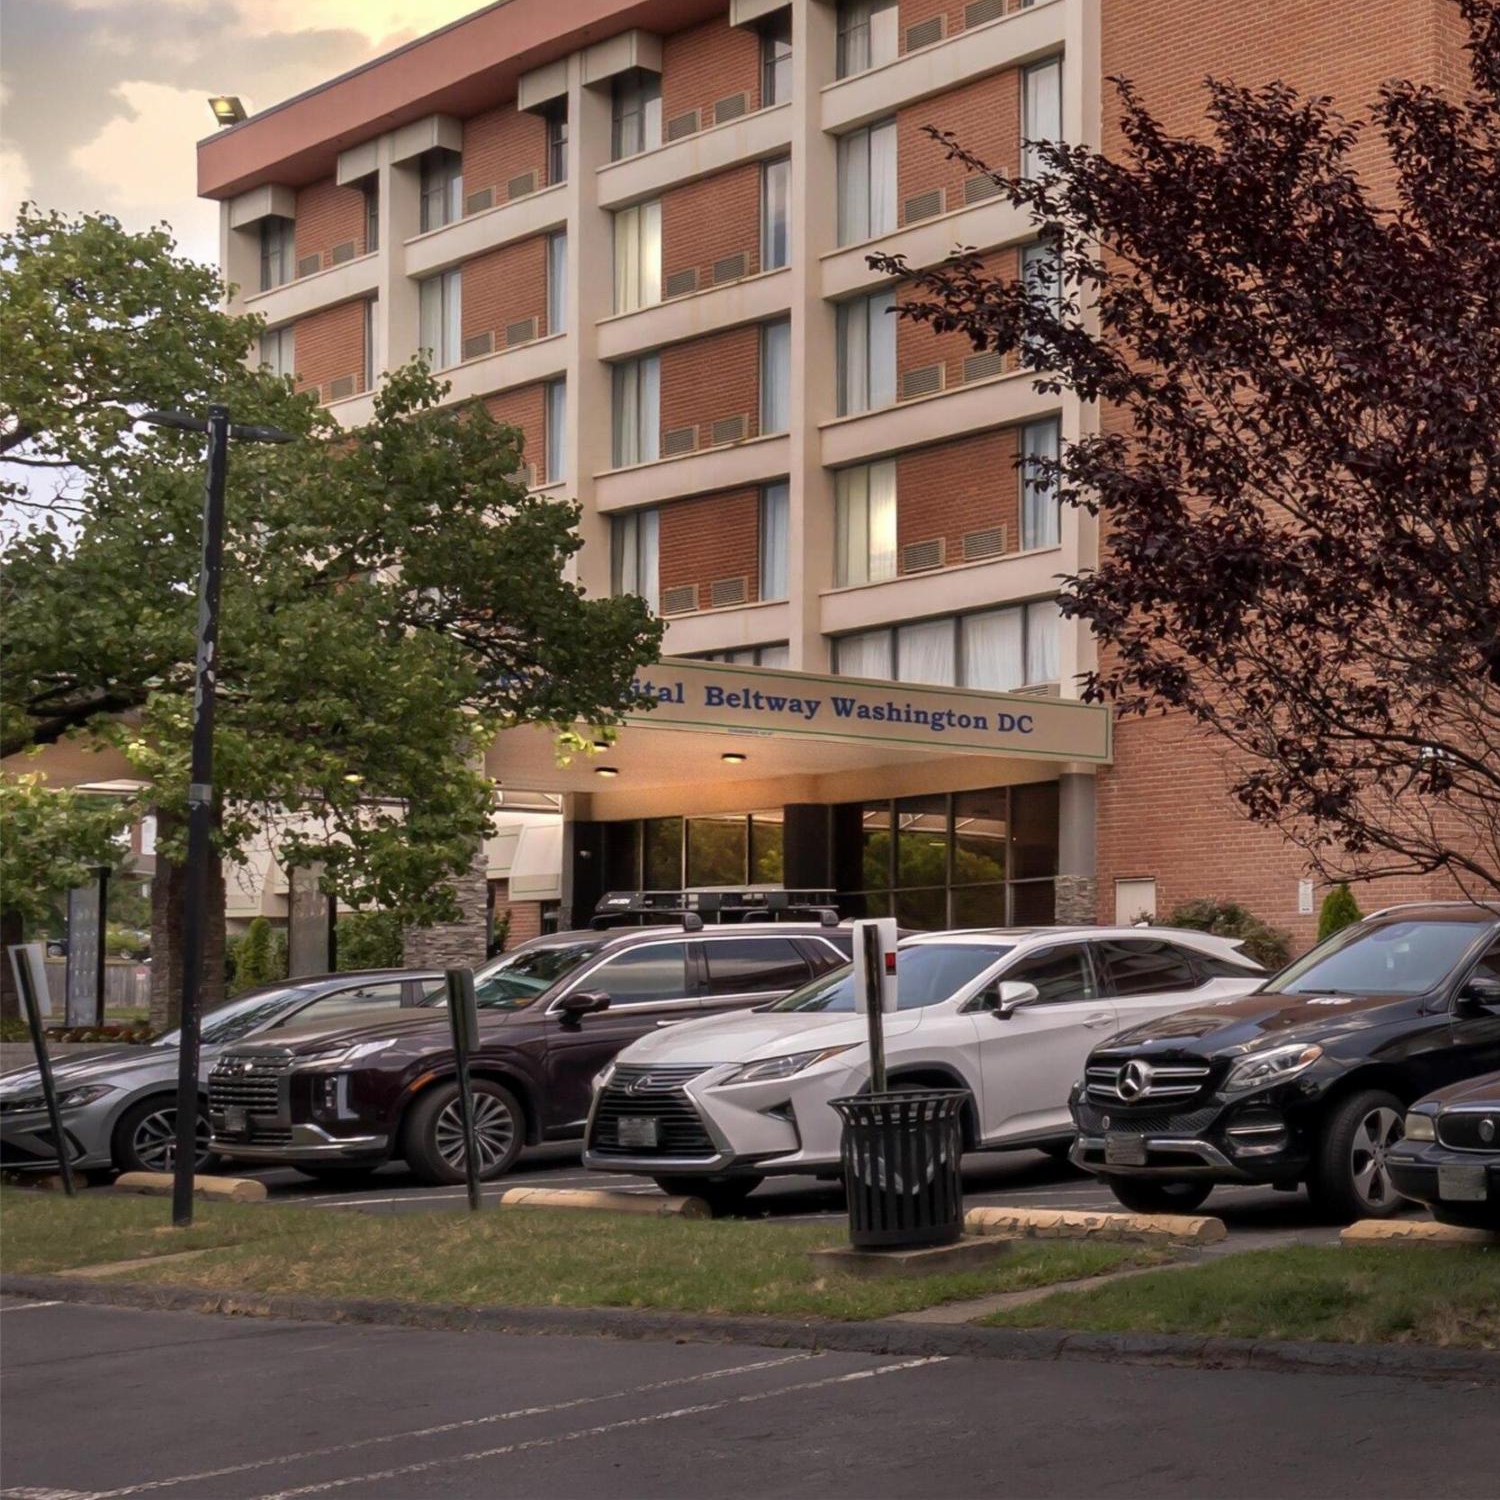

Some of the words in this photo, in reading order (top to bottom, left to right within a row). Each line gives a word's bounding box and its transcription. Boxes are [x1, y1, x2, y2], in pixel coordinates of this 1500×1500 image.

[704, 685, 822, 720] Beltway
[830, 696, 989, 732] Washington
[997, 712, 1034, 734] DC
